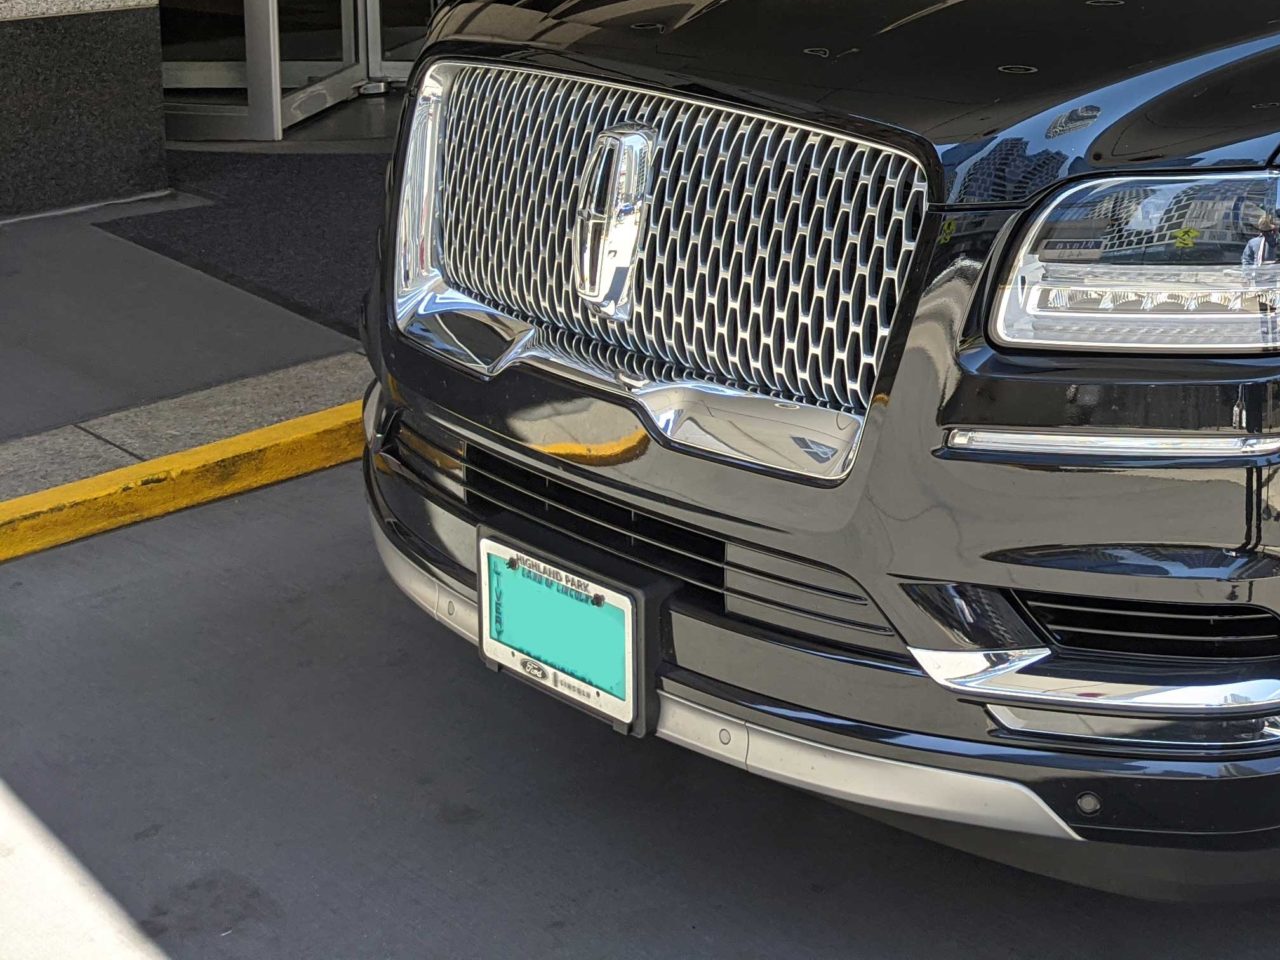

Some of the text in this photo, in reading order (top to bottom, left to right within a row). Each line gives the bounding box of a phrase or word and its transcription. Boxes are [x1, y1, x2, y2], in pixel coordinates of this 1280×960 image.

[516, 553, 590, 594] HIGHLAND PARK
[525, 661, 543, 678] Ford
